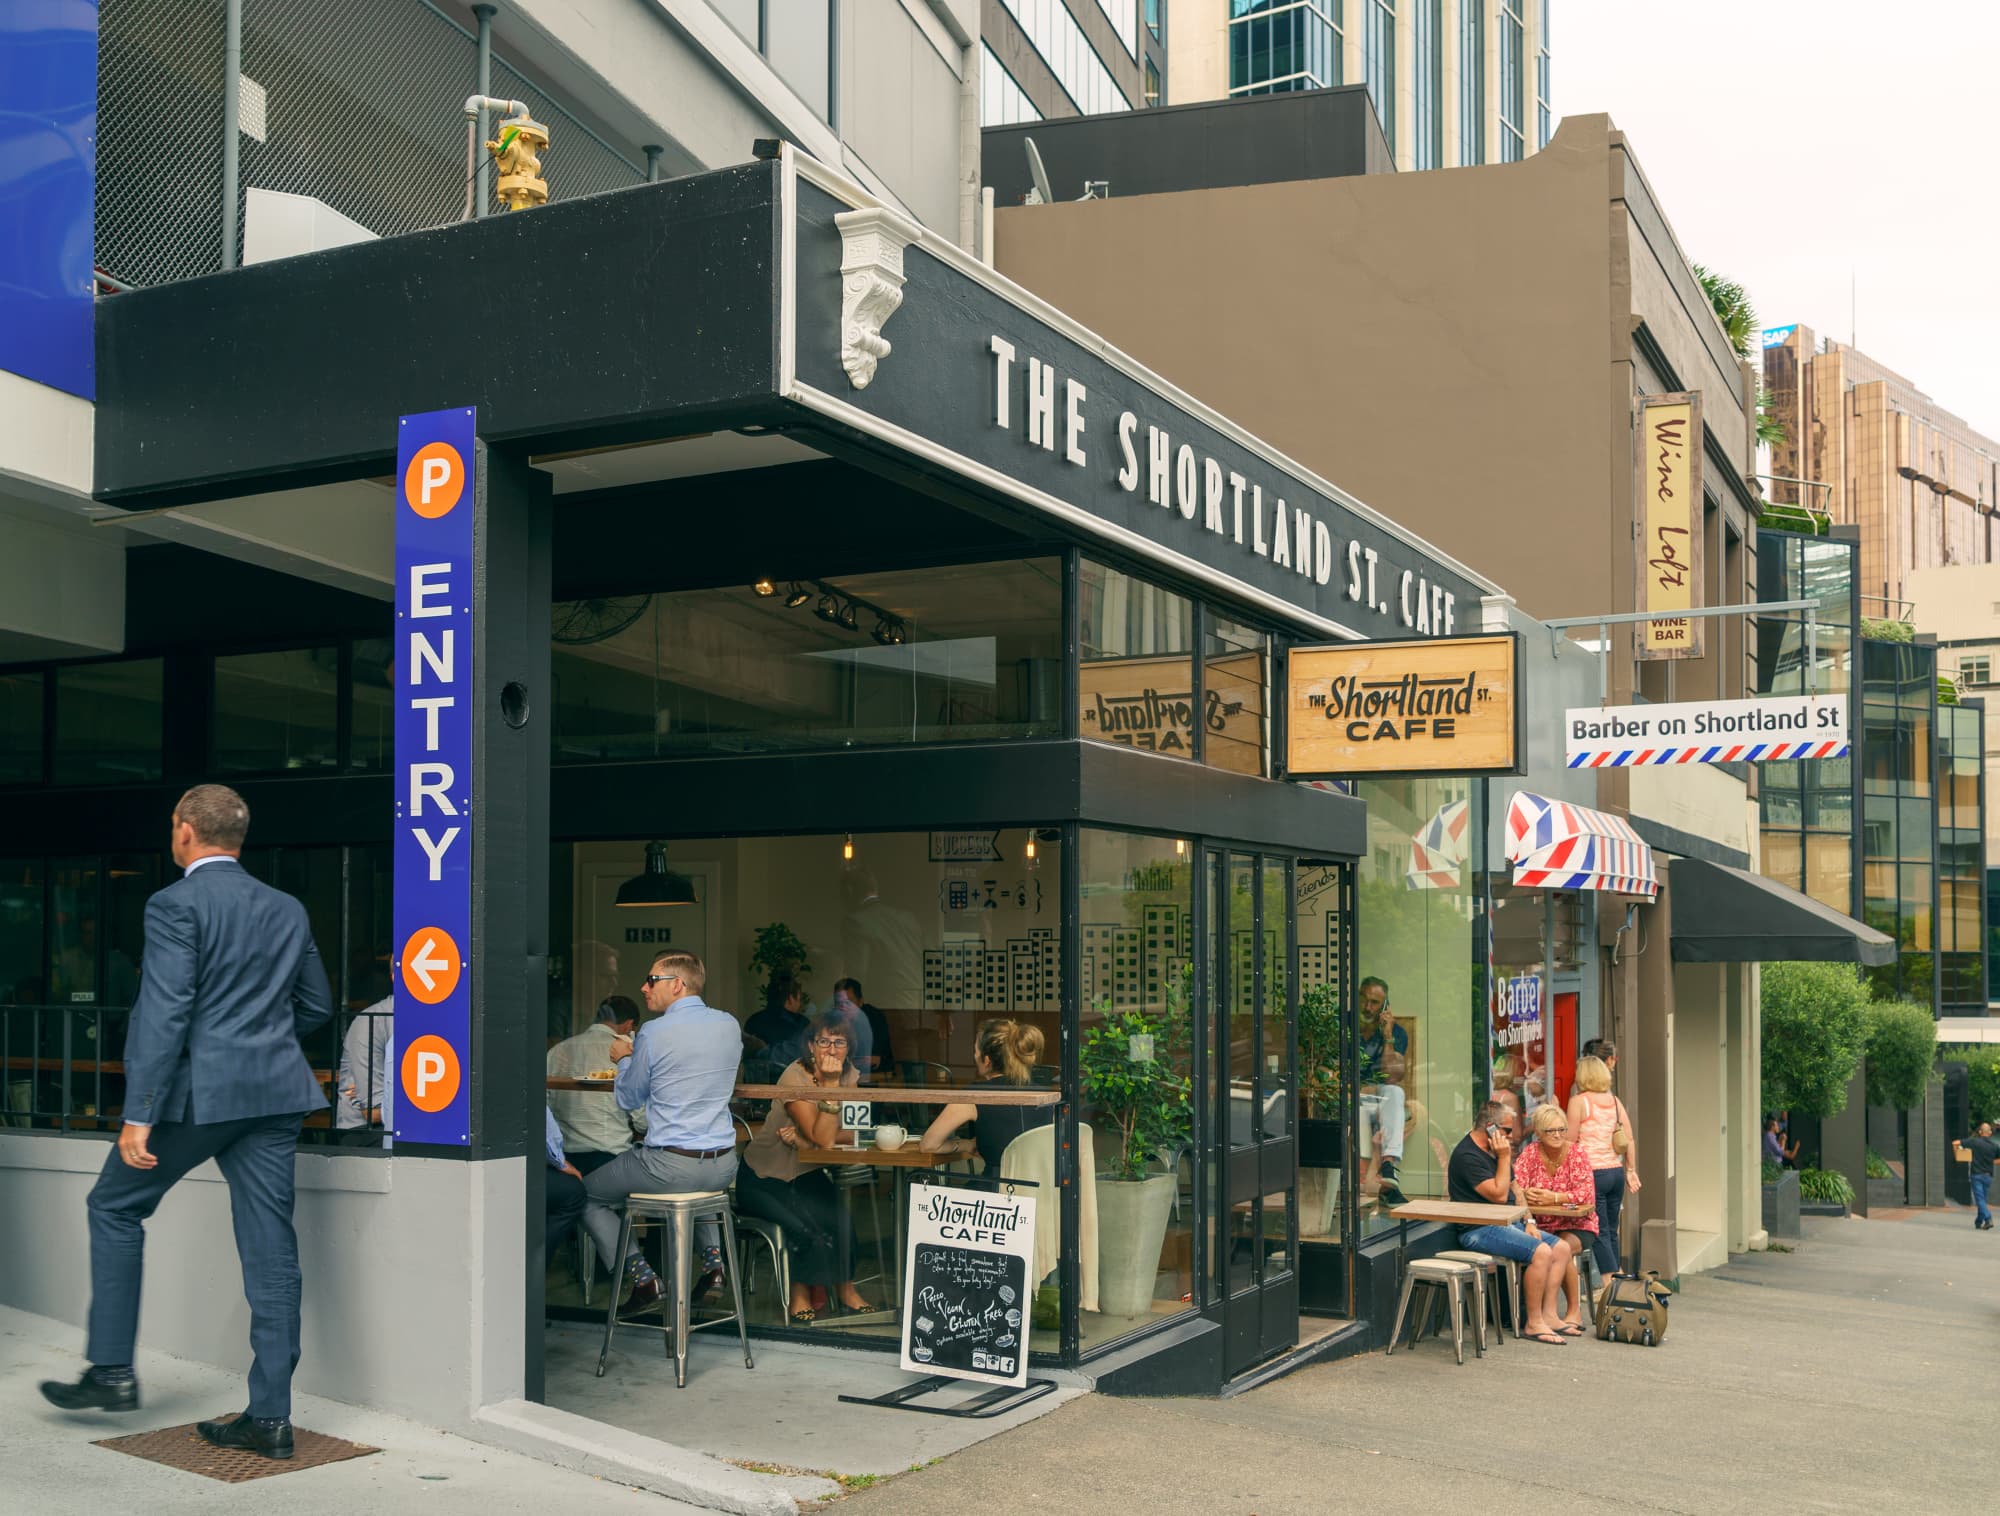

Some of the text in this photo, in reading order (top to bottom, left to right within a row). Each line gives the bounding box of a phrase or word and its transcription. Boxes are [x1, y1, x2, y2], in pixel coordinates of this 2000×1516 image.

[1763, 330, 1790, 345] SAP
[1655, 418, 1687, 503] Wine
[421, 457, 451, 505] P
[991, 334, 1455, 637] THE SHORTLAND ST. CAFE
[1649, 526, 1689, 591] Loft
[1651, 617, 1687, 627] WINE
[1655, 629, 1684, 640] BAR
[1309, 671, 1492, 719] THE Shortland ST.
[410, 562, 462, 881] ENTRY
[1346, 718, 1456, 742] CAFE
[1573, 706, 1839, 740] Barber on Shortland St
[1498, 970, 1541, 1017] Barber
[1498, 1028, 1508, 1048] on
[417, 1052, 446, 1098] P
[844, 1105, 870, 1126] Q2
[918, 1203, 929, 1213] THE
[928, 1194, 1020, 1232] Shortland
[940, 1225, 1006, 1246] CAFE
